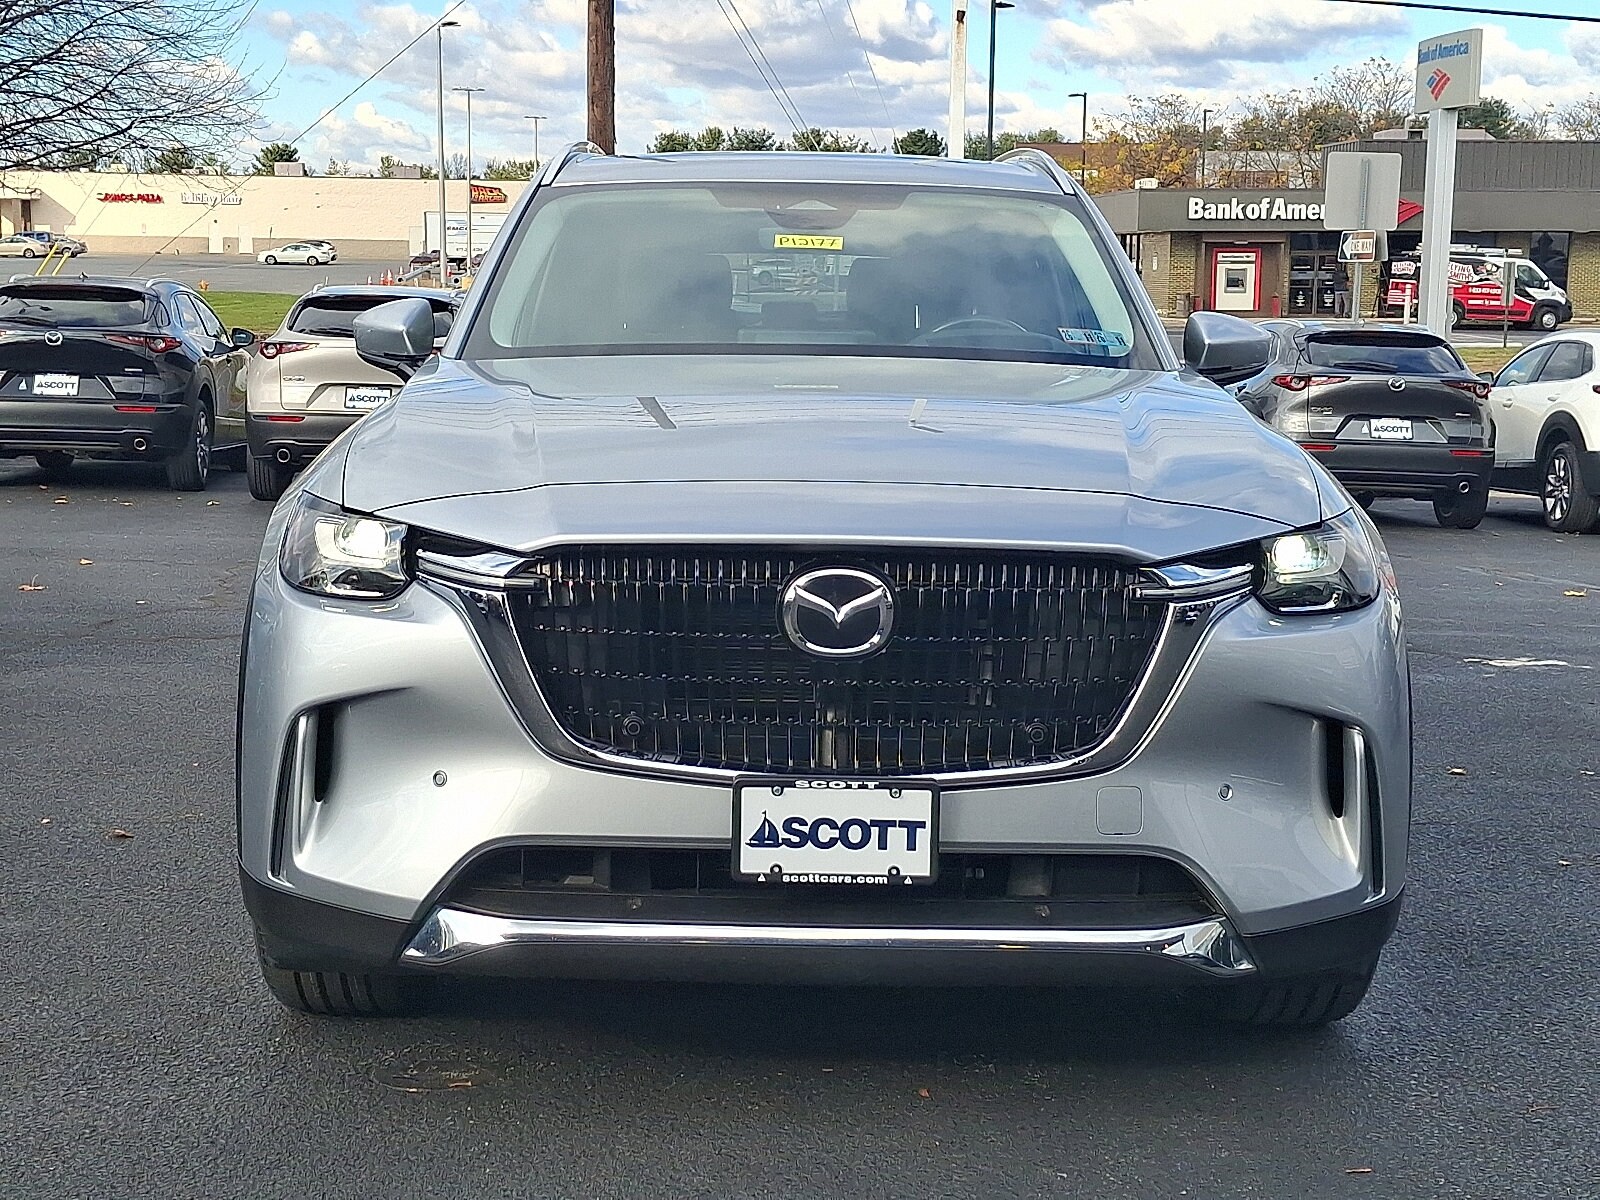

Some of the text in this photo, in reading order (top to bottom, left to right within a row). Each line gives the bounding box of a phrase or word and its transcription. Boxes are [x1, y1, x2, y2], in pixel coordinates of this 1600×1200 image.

[1188, 197, 1244, 220] Bank
[1249, 197, 1271, 220] of
[44, 381, 76, 389] SCOTT
[1379, 425, 1410, 433] SCOTT
[795, 780, 880, 789] SCOTT
[781, 816, 927, 851] SCOTT
[782, 874, 888, 885] scottcars.com
